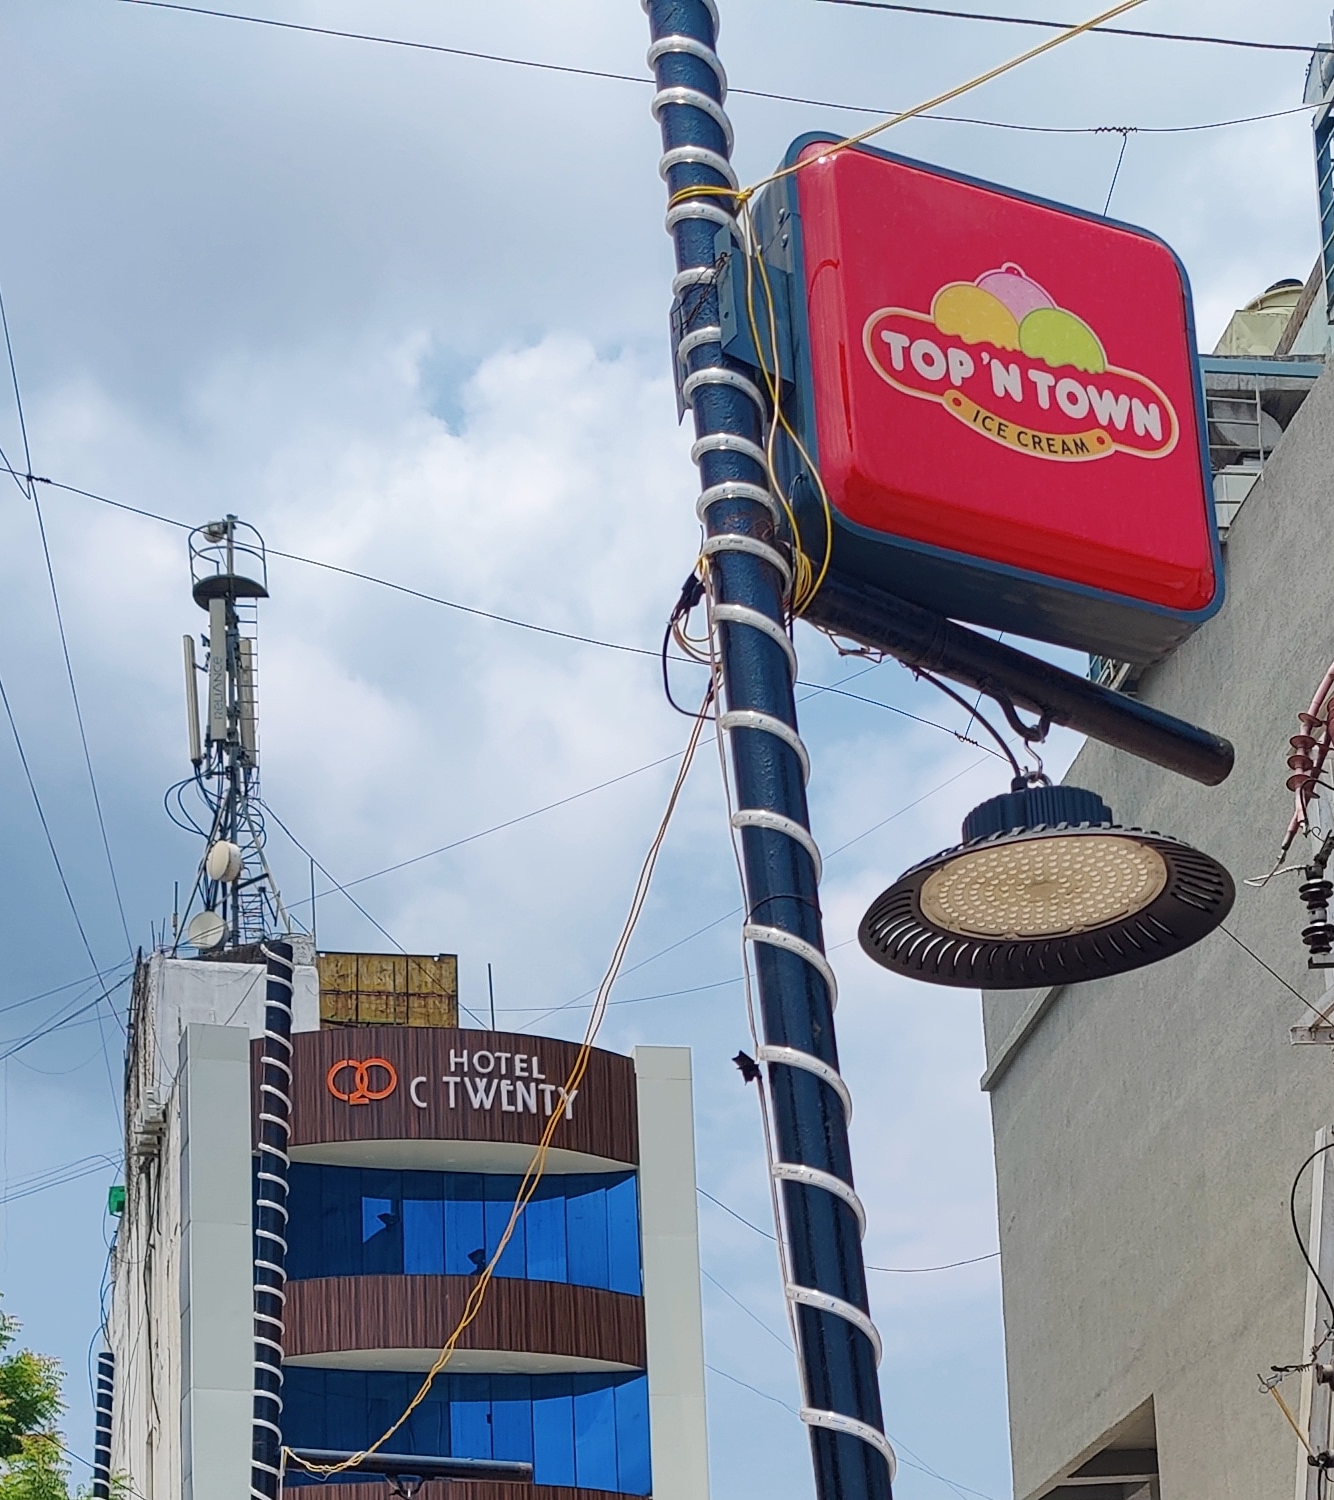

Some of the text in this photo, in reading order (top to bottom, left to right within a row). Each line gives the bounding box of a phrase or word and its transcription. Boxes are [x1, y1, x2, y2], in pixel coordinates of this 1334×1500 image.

[880, 330, 974, 387] TOP
[1027, 370, 1163, 441] TOWN
[972, 409, 1091, 456] ICE CREAM
[449, 1049, 546, 1080] HOTEL
[410, 1076, 579, 1120] C TWENTY
